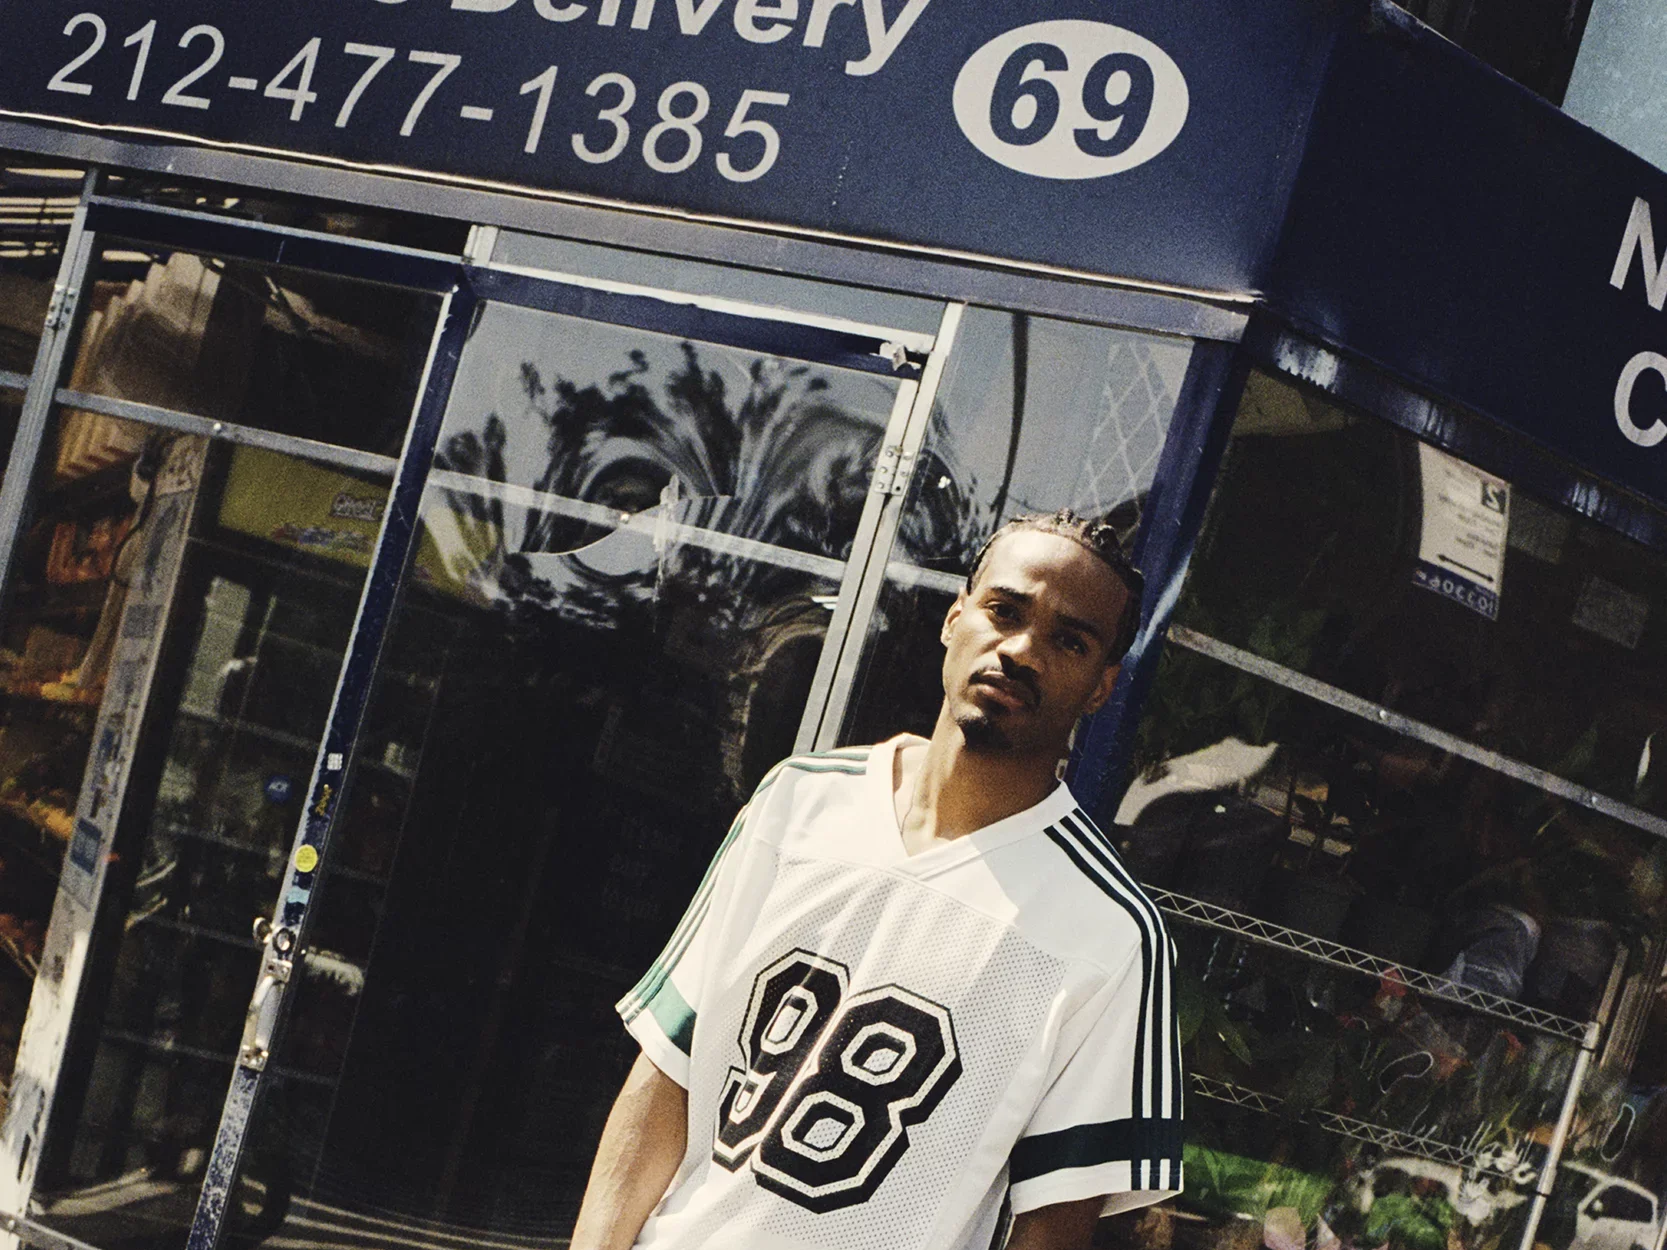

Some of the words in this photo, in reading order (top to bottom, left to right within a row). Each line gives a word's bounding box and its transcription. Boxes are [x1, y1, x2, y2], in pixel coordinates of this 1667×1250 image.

[47, 13, 790, 182] 212-477-1385
[449, 0, 932, 76] every
[988, 42, 1155, 158] 69
[712, 947, 964, 1214] 98
